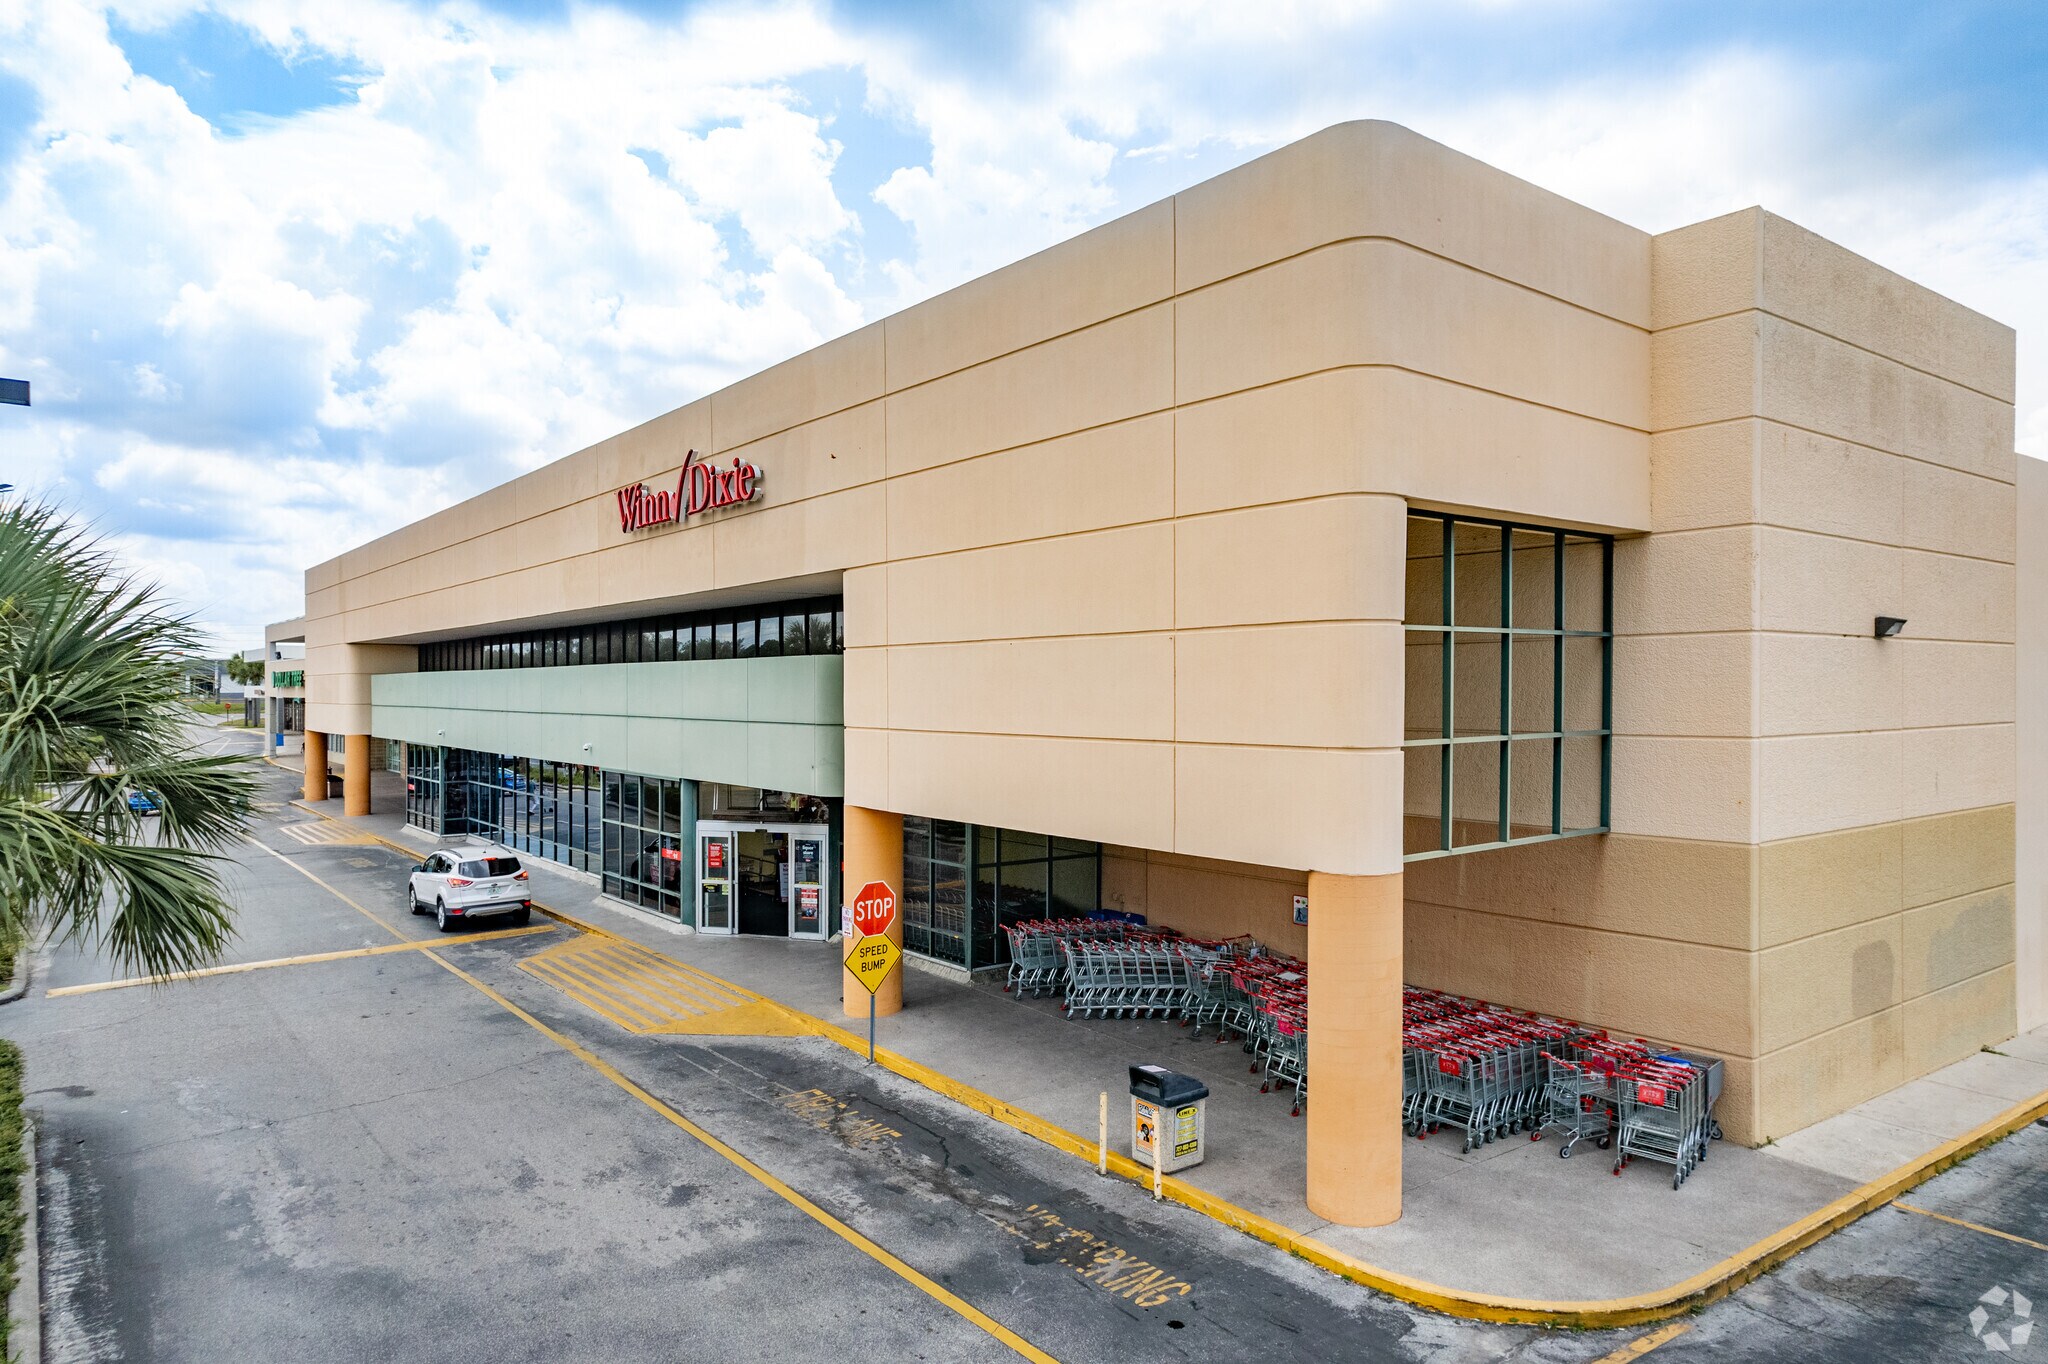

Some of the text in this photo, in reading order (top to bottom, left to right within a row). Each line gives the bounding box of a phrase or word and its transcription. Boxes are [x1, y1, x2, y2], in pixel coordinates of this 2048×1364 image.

[686, 457, 758, 515] Dixie
[855, 897, 893, 922] STOP
[859, 943, 889, 958] SPEED
[861, 958, 886, 973] BUMP
